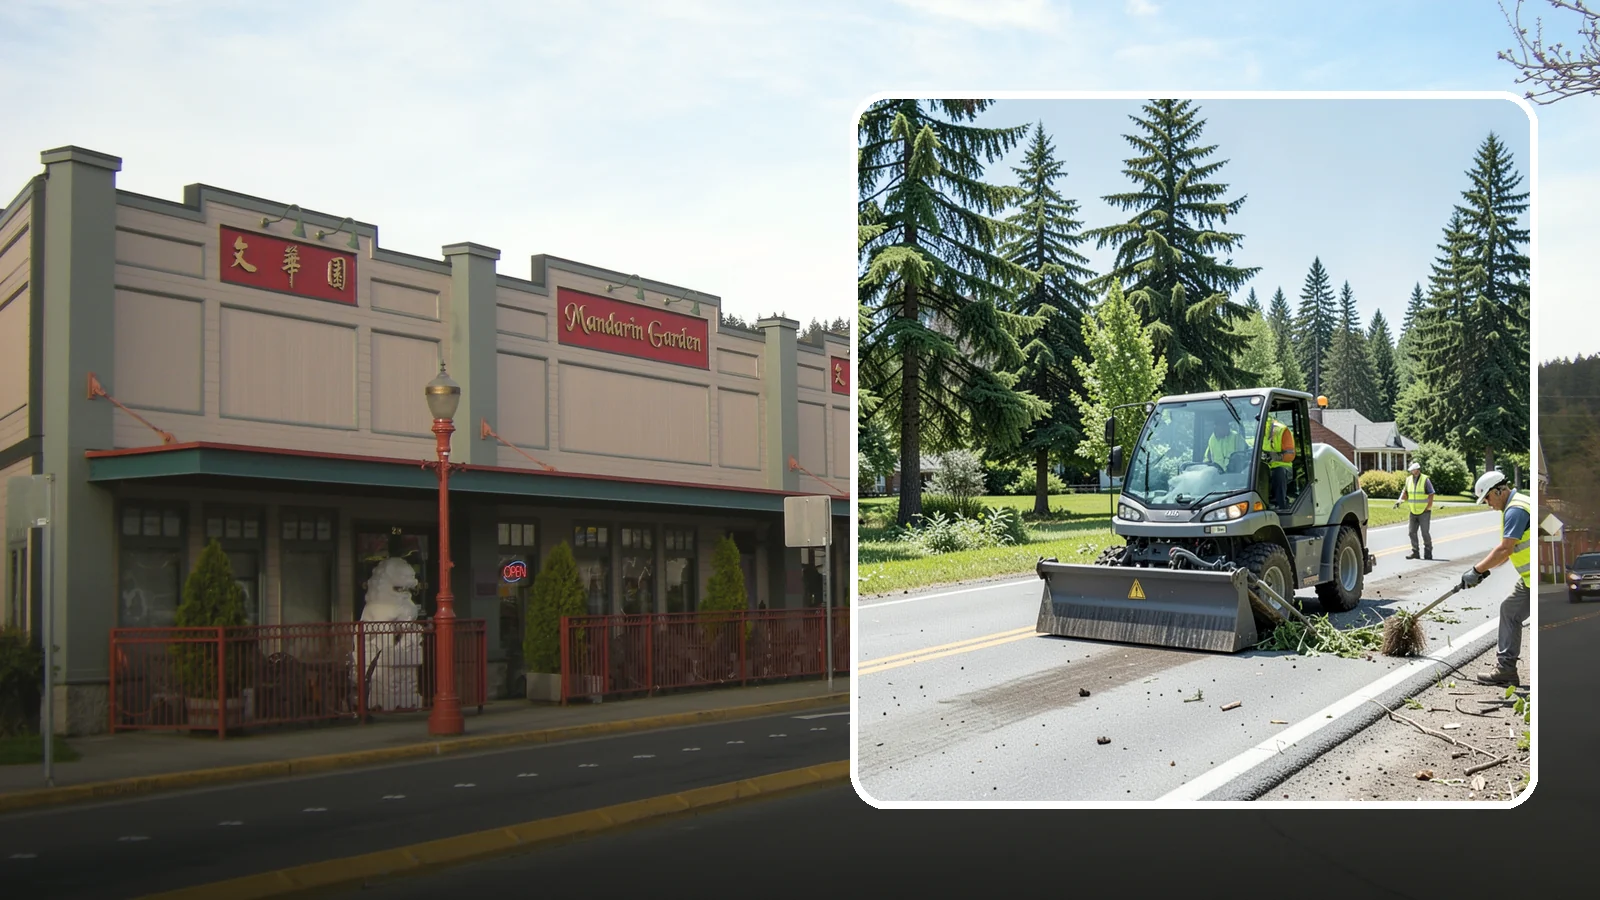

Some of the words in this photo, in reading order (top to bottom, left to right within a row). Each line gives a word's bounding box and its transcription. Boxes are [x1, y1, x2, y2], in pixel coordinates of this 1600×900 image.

[231, 236, 346, 291] 文華園
[564, 302, 644, 341] Mandarin
[647, 320, 701, 352] Garden
[503, 565, 527, 578] OPEN
